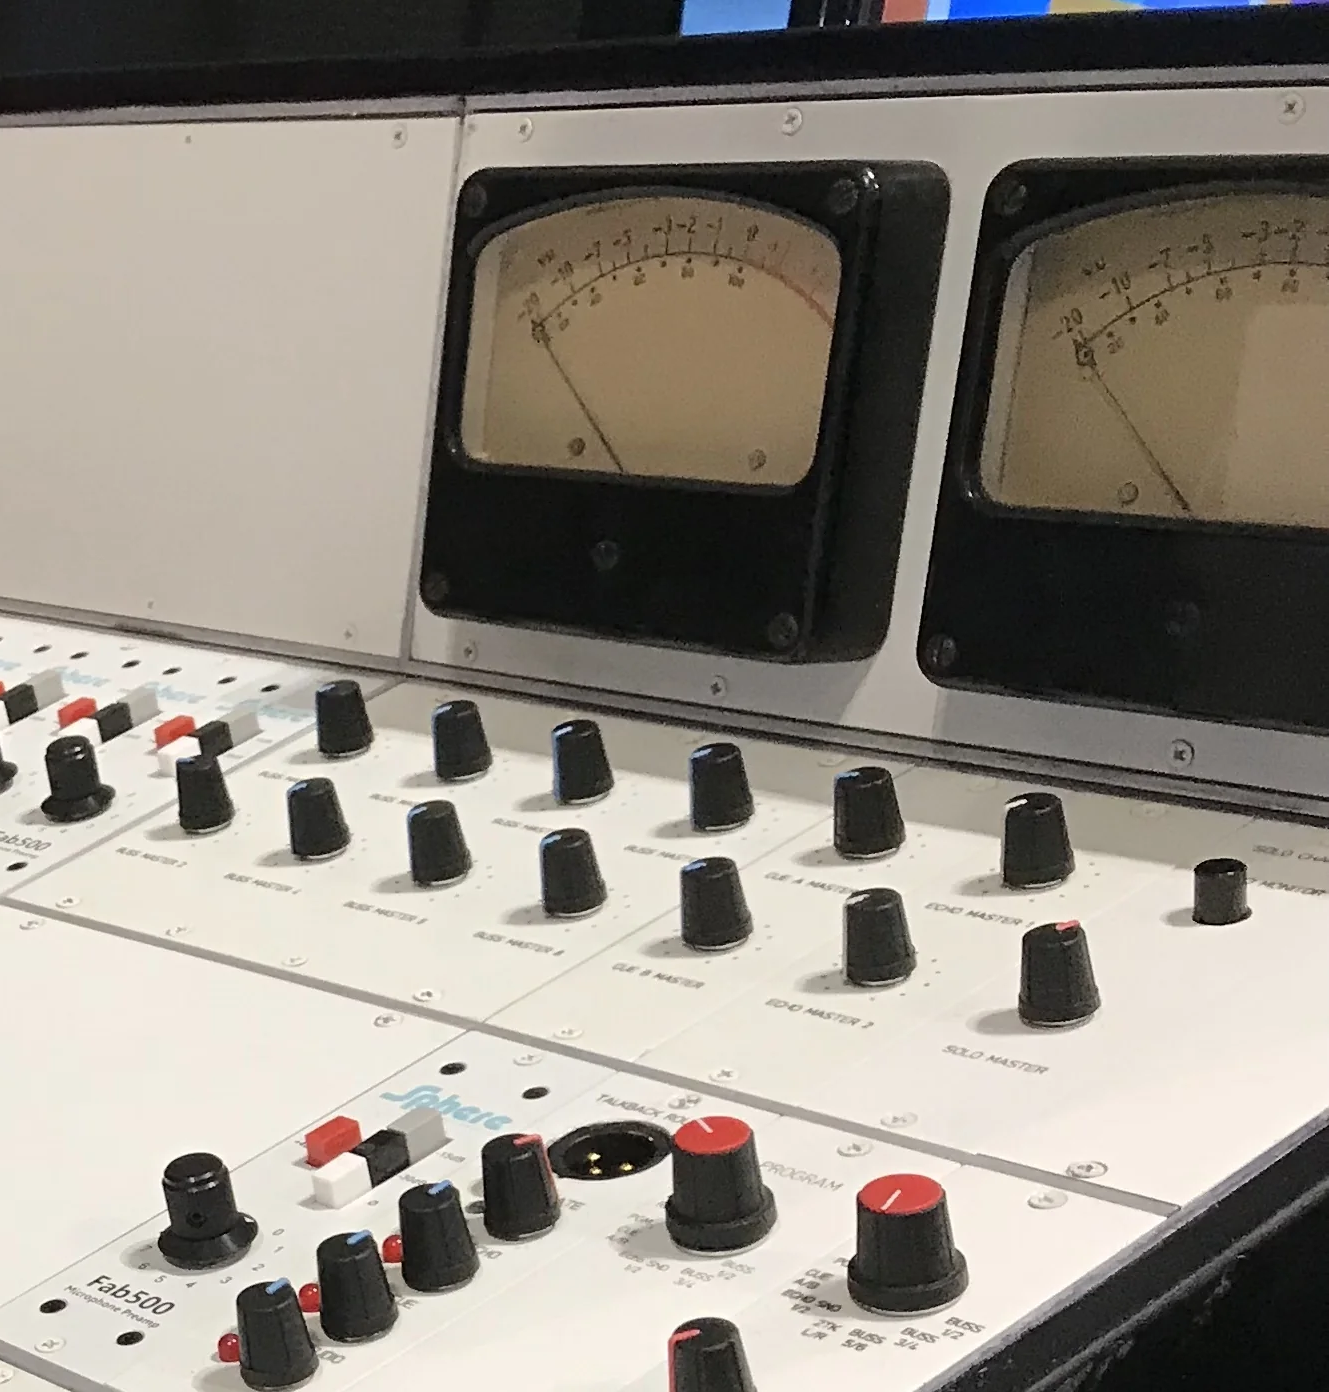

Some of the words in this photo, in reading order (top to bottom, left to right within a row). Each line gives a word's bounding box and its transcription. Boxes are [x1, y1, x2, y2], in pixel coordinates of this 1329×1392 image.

[924, 901, 965, 915] ECHO
[965, 909, 1023, 927] MASTER
[652, 971, 706, 990] MASTER
[765, 998, 804, 1013] ECHO
[803, 1006, 861, 1027] MASTER
[942, 1044, 984, 1060] SOLO
[985, 1054, 1050, 1075] MASTER
[379, 1085, 513, 1130] Sphere
[595, 1093, 660, 1118] TALKBACK
[760, 1160, 845, 1192] PROGRAM
[681, 1267, 715, 1283] BUSS
[63, 1284, 121, 1312] Microphone
[120, 1306, 160, 1330] Preamp
[86, 1274, 176, 1316] Fab500
[848, 1328, 887, 1345] BUSS
[900, 1327, 940, 1344] BUSS
[945, 1316, 987, 1334] BUSS
[841, 1339, 868, 1352] 5/6
[893, 1338, 920, 1351] 3/4
